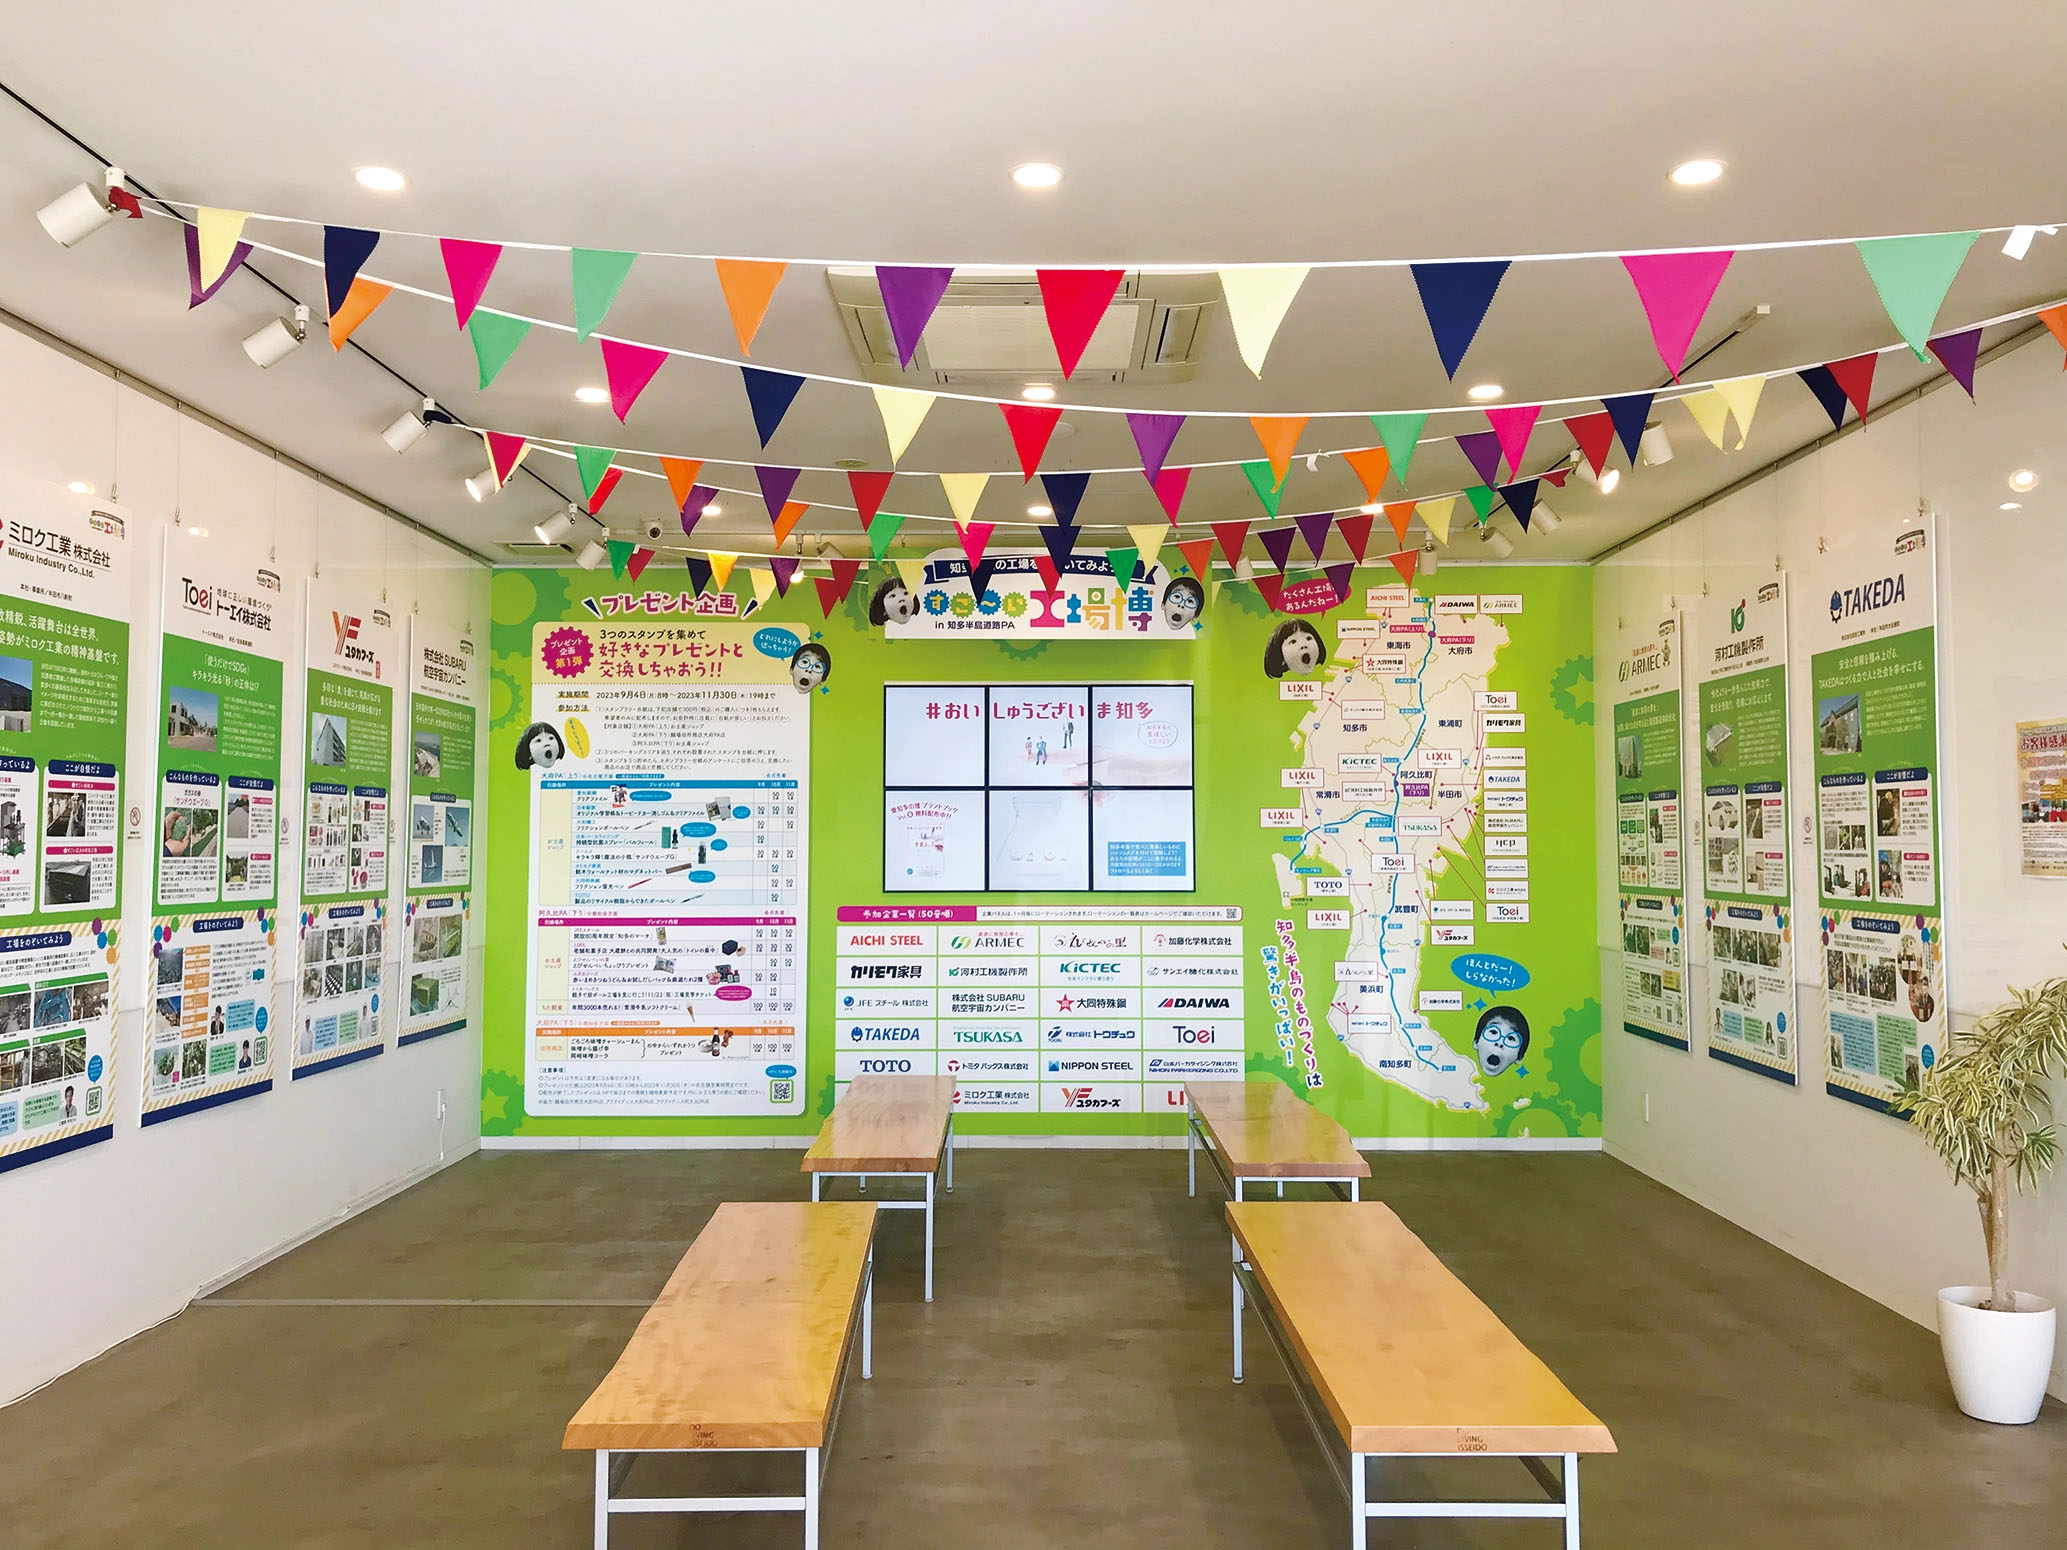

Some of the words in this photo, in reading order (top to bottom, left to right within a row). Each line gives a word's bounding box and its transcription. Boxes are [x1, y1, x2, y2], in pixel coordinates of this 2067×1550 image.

[9, 521, 72, 557] ミロク工業
[73, 544, 111, 568] 株式会社
[8, 547, 35, 562] Miroku
[36, 552, 67, 573] Industry
[182, 577, 213, 610] Toei
[1843, 574, 1906, 617] TAKEDA
[602, 593, 737, 615] プレゼント企画
[216, 600, 272, 631] トーエイ株式会社
[935, 621, 945, 630] in
[947, 621, 1015, 630] 知多半島道路PA
[600, 629, 707, 640] 3つのスタンプを集めて
[551, 638, 582, 649] プレゼント
[1386, 641, 1411, 649] 東海市
[560, 647, 576, 656] 企画
[599, 641, 743, 658] 好きなプレゼントと
[1448, 647, 1473, 655] 大府市
[444, 654, 467, 671] SUBARU
[1631, 652, 1661, 677] ARMEC
[599, 660, 722, 678] 交換しちゃおう!!
[1287, 683, 1314, 692] LIXIL
[1485, 694, 1507, 703] Toei
[1342, 724, 1368, 732] 知多市
[1438, 719, 1463, 728] 東浦町
[1426, 752, 1453, 760] LIXIL
[1289, 771, 1316, 779] LIXIL
[1400, 771, 1433, 779] 阿久比町
[1315, 790, 1340, 799] 常滑市
[1438, 790, 1462, 799] 半田市
[1268, 811, 1295, 819] LIXIL
[1382, 857, 1404, 866] Toei
[1394, 905, 1419, 913] 武豊町
[1497, 906, 1519, 916] Toei
[1315, 913, 1342, 921] LIXIL
[850, 936, 886, 946] AICHI
[890, 936, 923, 946] STEEL
[975, 937, 1025, 948] ARMEC
[1168, 937, 1232, 946] 加藤化学株式会社
[850, 965, 922, 979] カリモク家具
[960, 967, 1028, 977] 河村工機製作所
[1162, 967, 1239, 976] サンエイ糖化株式会社
[1360, 985, 1384, 993] 美浜町
[952, 993, 984, 1001] 株式会社
[902, 999, 928, 1007] 株式会社
[1077, 998, 1127, 1009] 大同特殊鋼
[1174, 998, 1230, 1008] DAIWA
[951, 1004, 1025, 1013] 航空宇宙カンパニー
[865, 1027, 920, 1041] TAKEDA
[953, 1031, 1022, 1042] TSUKASA
[1093, 1030, 1136, 1039] トウチュウ
[1173, 1026, 1215, 1043] Toei
[860, 1060, 911, 1072] TOTO
[1061, 1062, 1099, 1070] NIPPON
[1101, 1062, 1134, 1070] STEEL
[1379, 1060, 1412, 1068] 南知多町
[964, 1091, 1003, 1099] ミロク工業
[1076, 1098, 1121, 1108] ユタカフーズ
